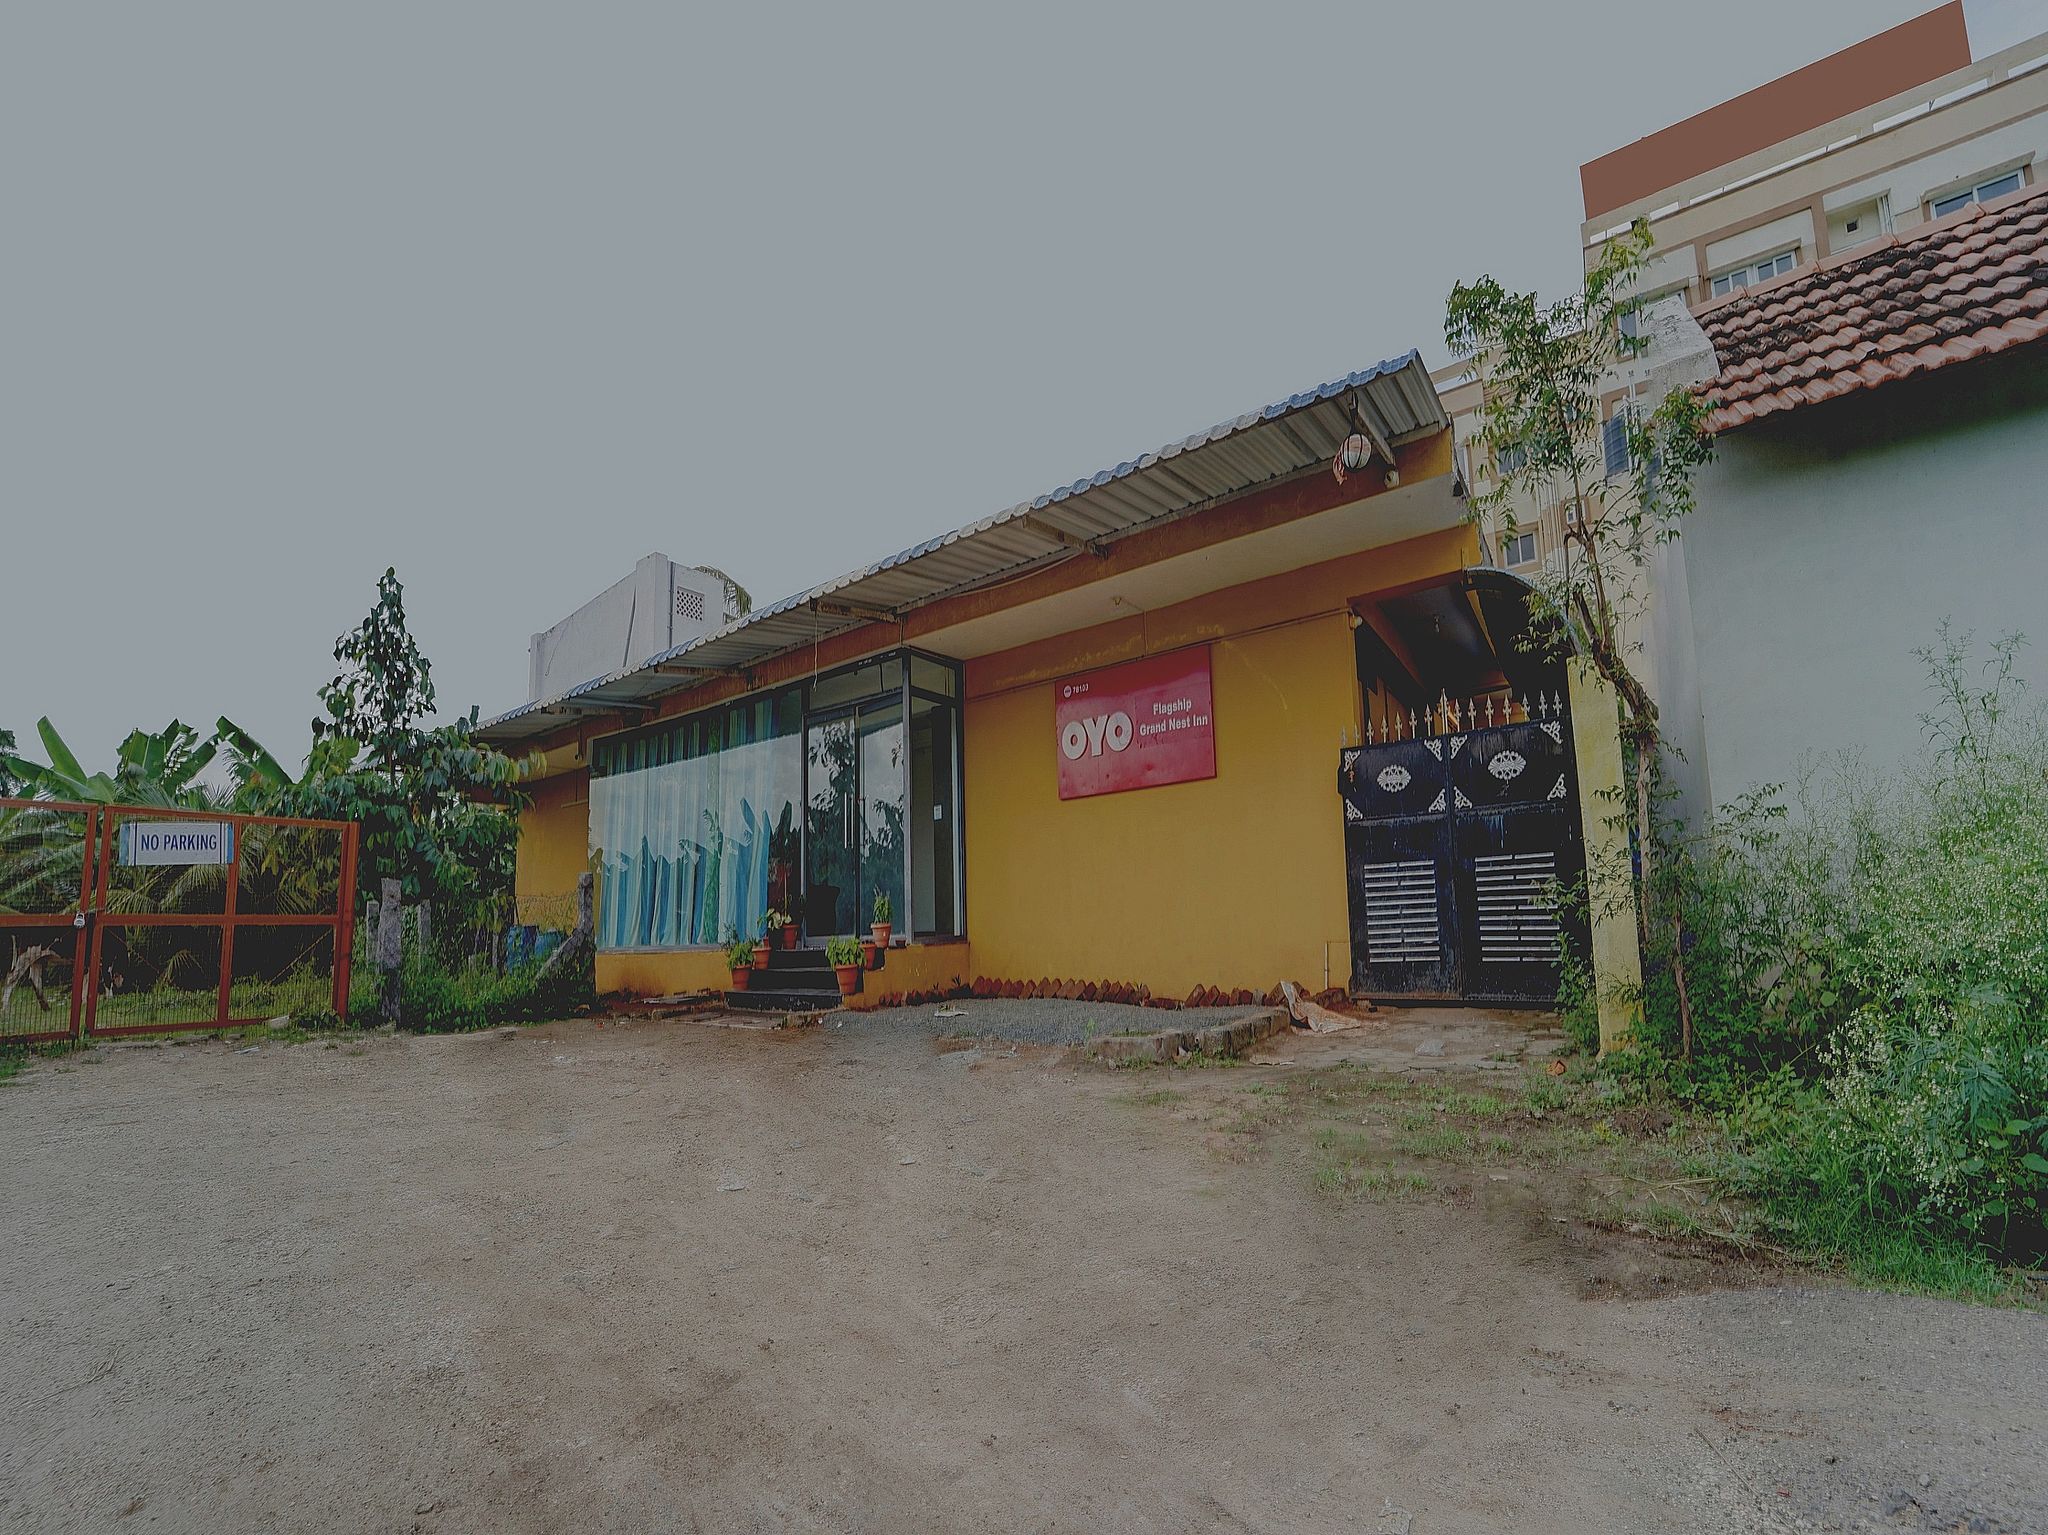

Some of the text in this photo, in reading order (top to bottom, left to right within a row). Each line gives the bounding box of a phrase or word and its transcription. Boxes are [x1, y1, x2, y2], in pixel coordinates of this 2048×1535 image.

[1153, 699, 1192, 715] Flagship
[1140, 715, 1208, 736] Grand Nest Inn
[1062, 712, 1133, 760] OYO
[141, 834, 217, 850] NO PARKING
